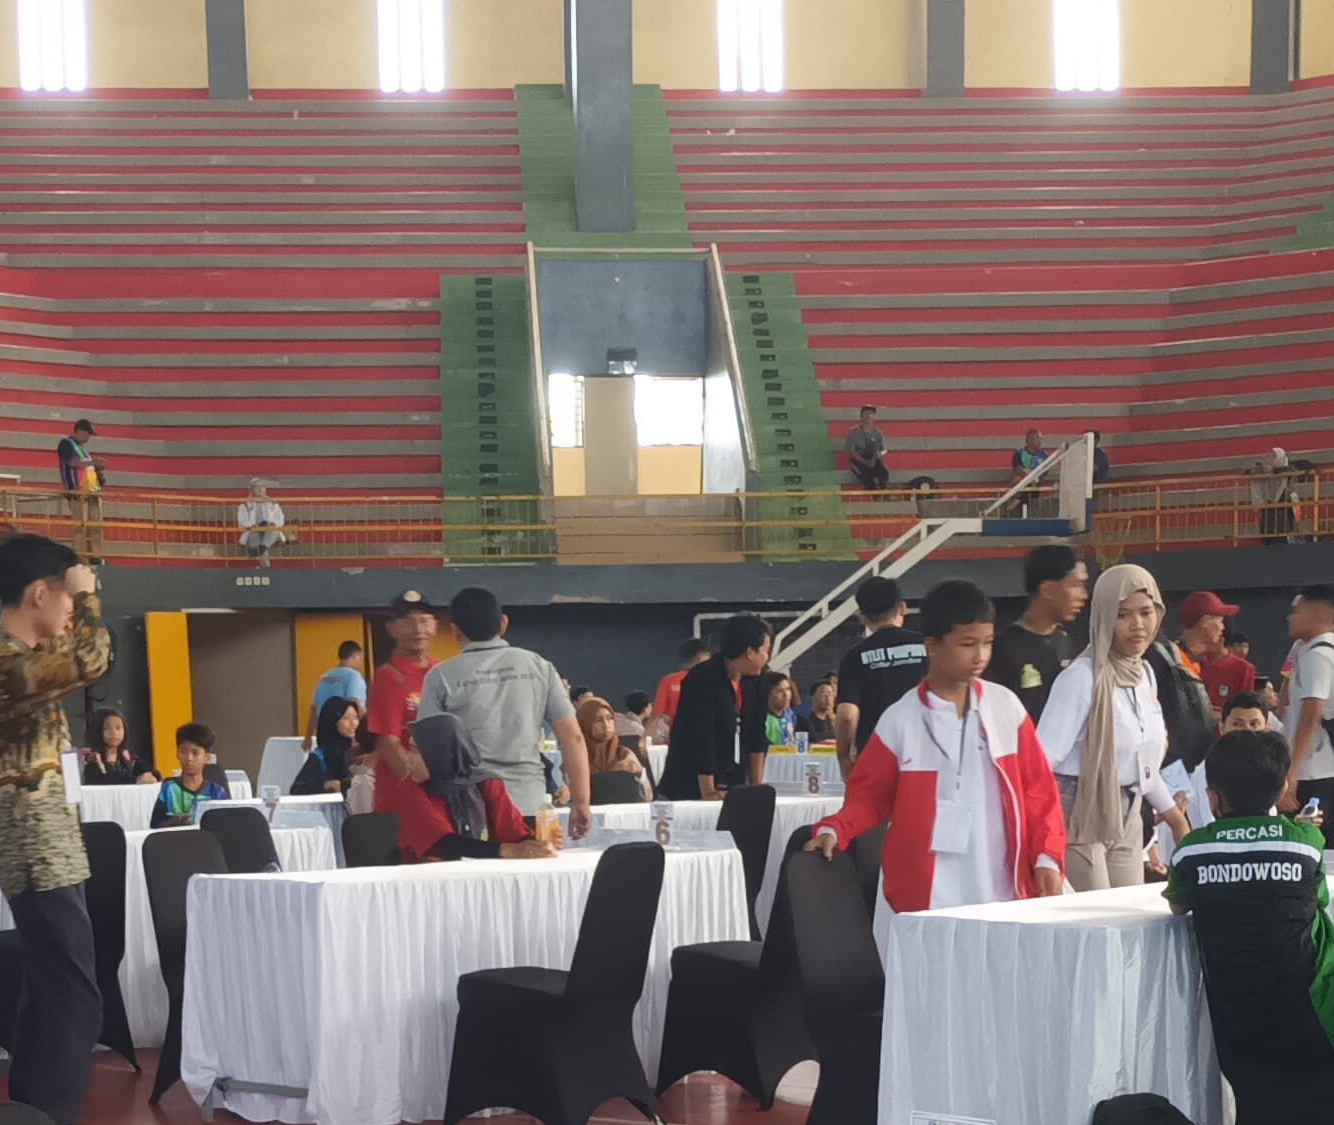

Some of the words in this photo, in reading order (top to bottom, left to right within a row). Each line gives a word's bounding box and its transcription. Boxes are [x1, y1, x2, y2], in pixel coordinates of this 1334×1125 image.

[808, 775, 820, 794] 8
[265, 801, 277, 823] 7
[655, 819, 671, 846] 6
[1216, 823, 1283, 840] PERCASI
[1197, 861, 1303, 885] BONDOWOSO
